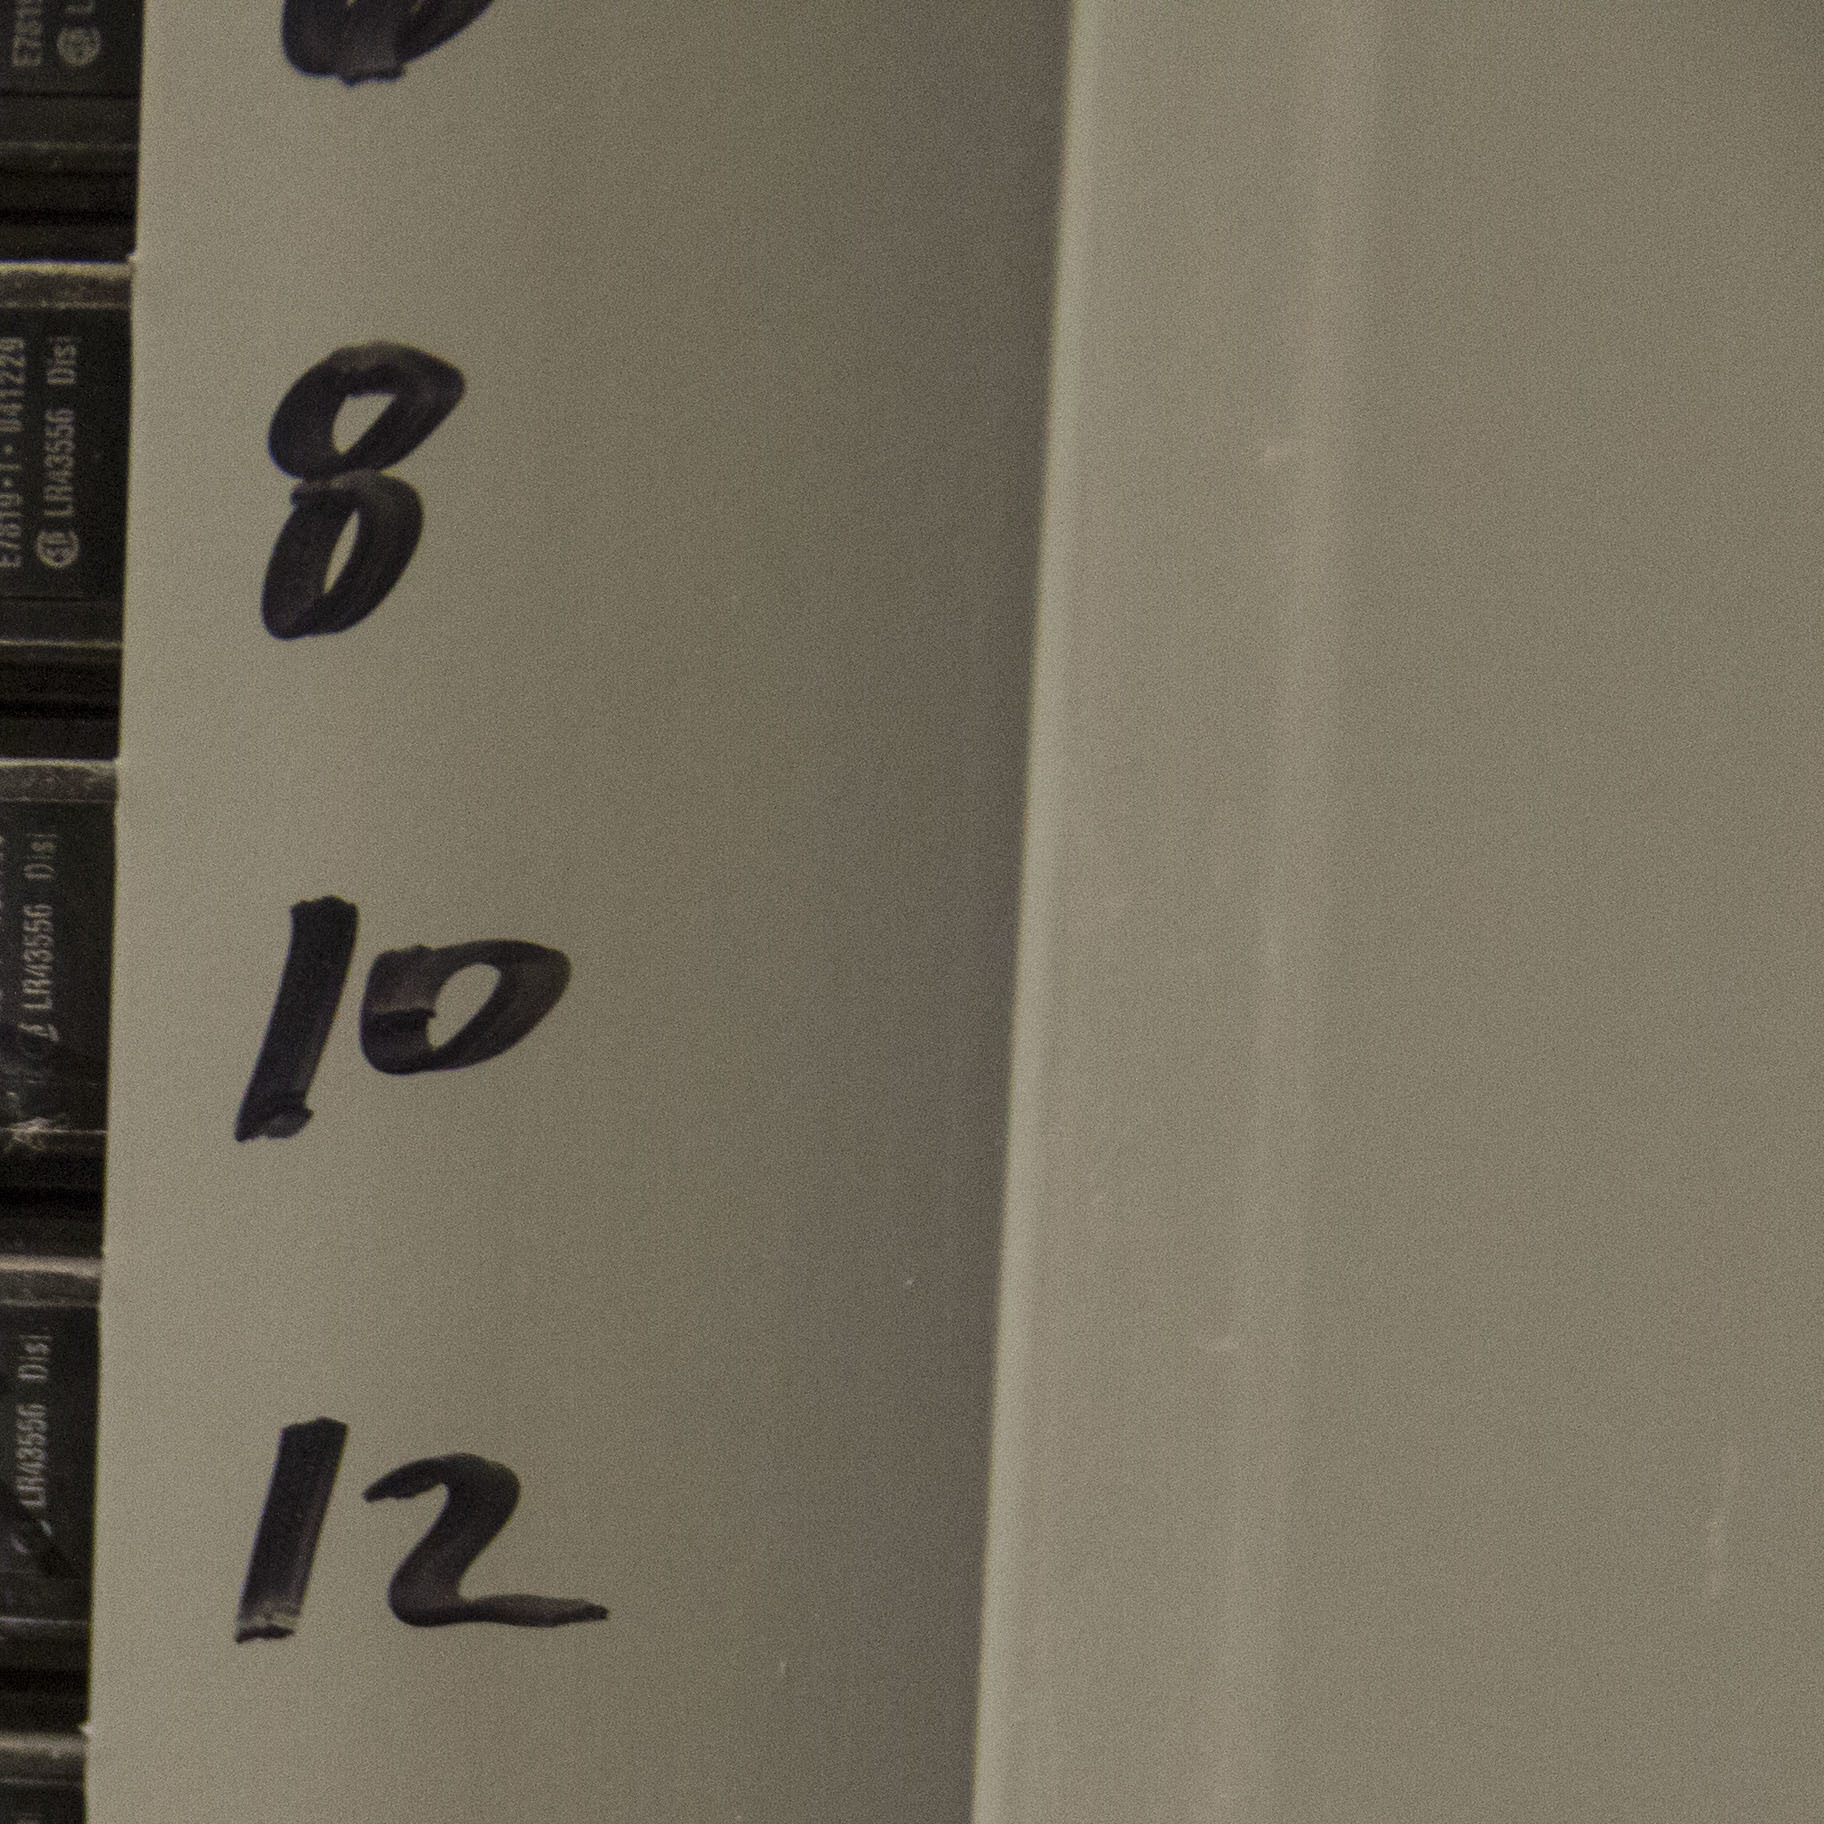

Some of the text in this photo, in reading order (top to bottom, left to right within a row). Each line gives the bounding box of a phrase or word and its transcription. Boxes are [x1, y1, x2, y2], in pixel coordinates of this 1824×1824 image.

[43, 406, 75, 517] LR43556
[260, 340, 466, 640] 8
[22, 902, 53, 1009] LR43556
[235, 896, 572, 1140] 10
[235, 1418, 610, 1642] 12
